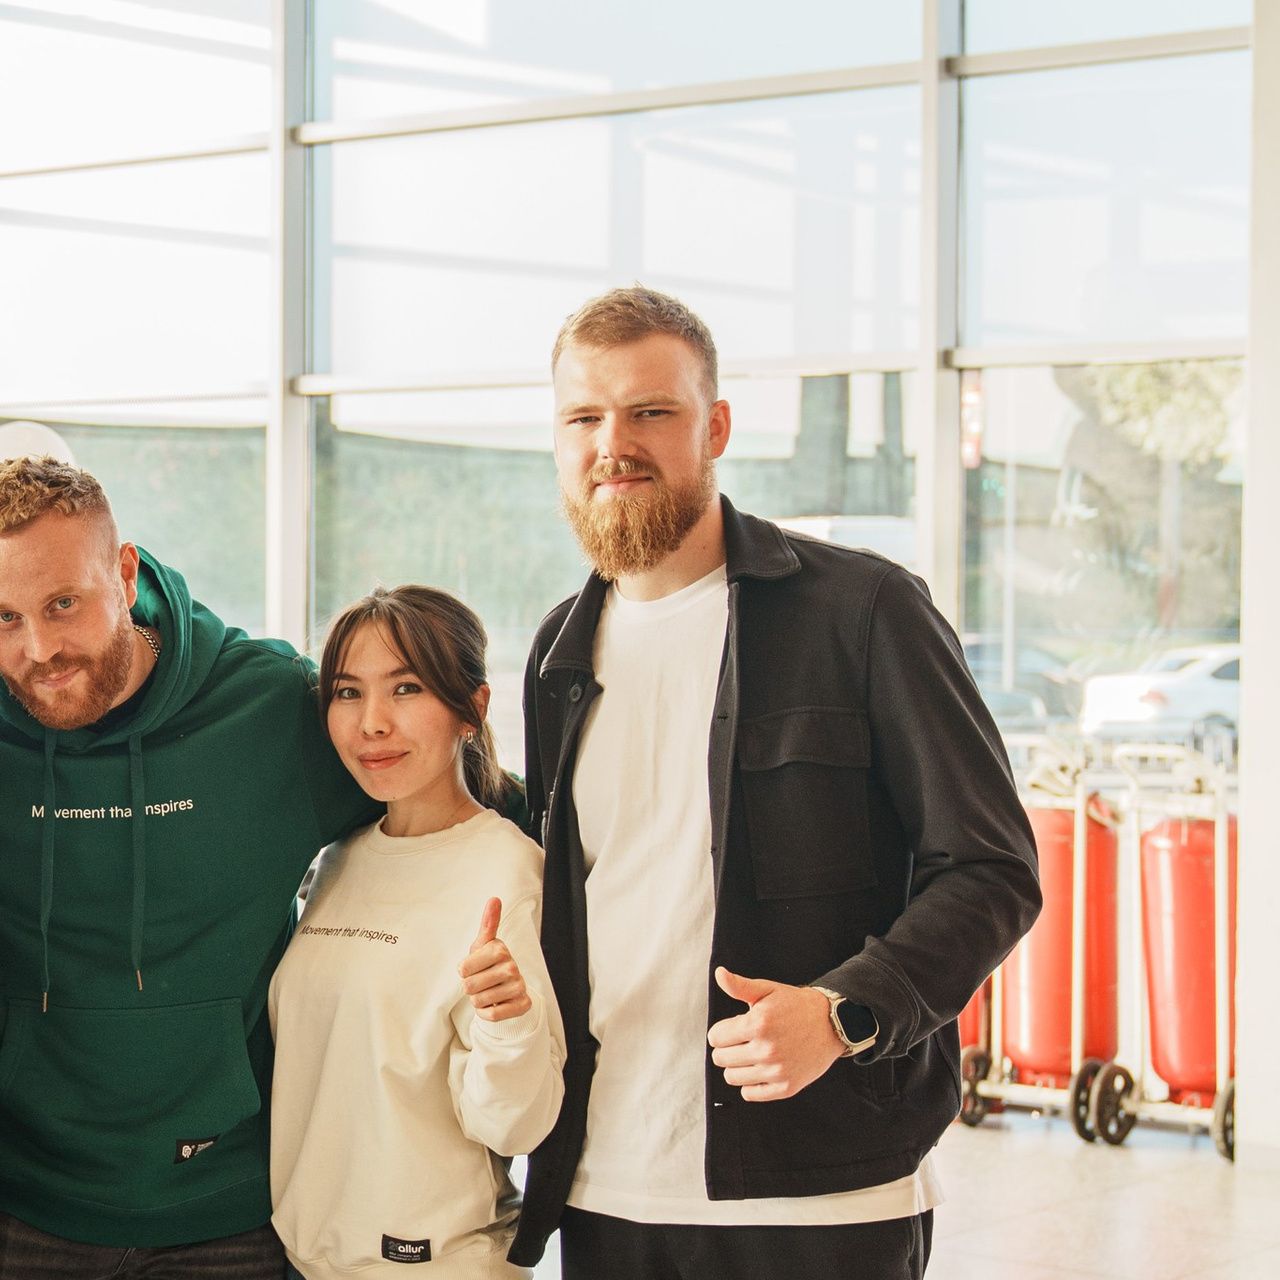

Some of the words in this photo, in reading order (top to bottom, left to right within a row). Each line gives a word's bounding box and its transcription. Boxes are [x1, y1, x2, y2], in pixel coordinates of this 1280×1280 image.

[31, 804, 106, 819] Mvement
[109, 805, 132, 819] tha
[144, 798, 194, 817] nspires
[300, 925, 342, 937] Movement
[343, 927, 359, 938] that
[359, 927, 399, 945] inspires
[397, 1244, 425, 1254] allur
